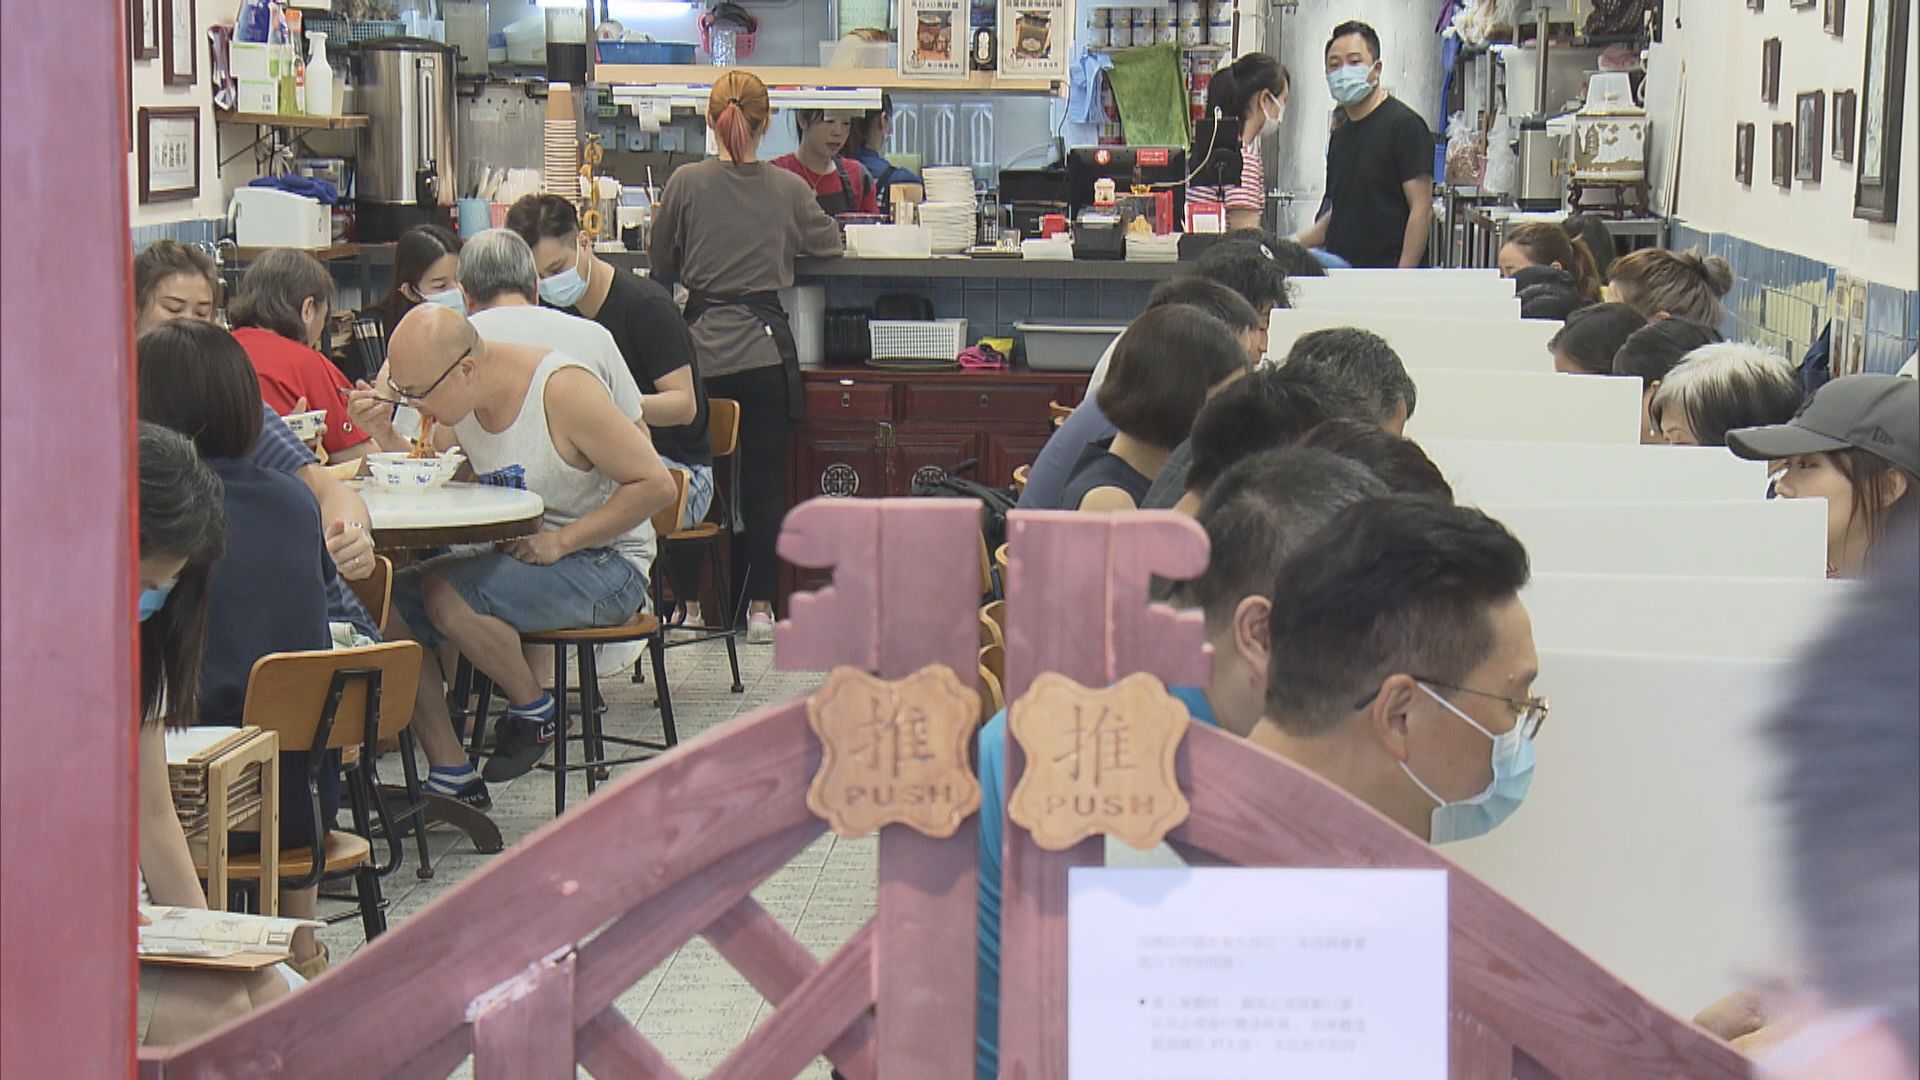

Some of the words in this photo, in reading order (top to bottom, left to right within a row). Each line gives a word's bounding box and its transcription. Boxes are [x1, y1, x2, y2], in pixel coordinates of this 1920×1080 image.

[849, 696, 936, 778] 推
[1053, 704, 1141, 789] 推
[846, 783, 951, 806] PUSH
[1047, 795, 1155, 816] PUSH
